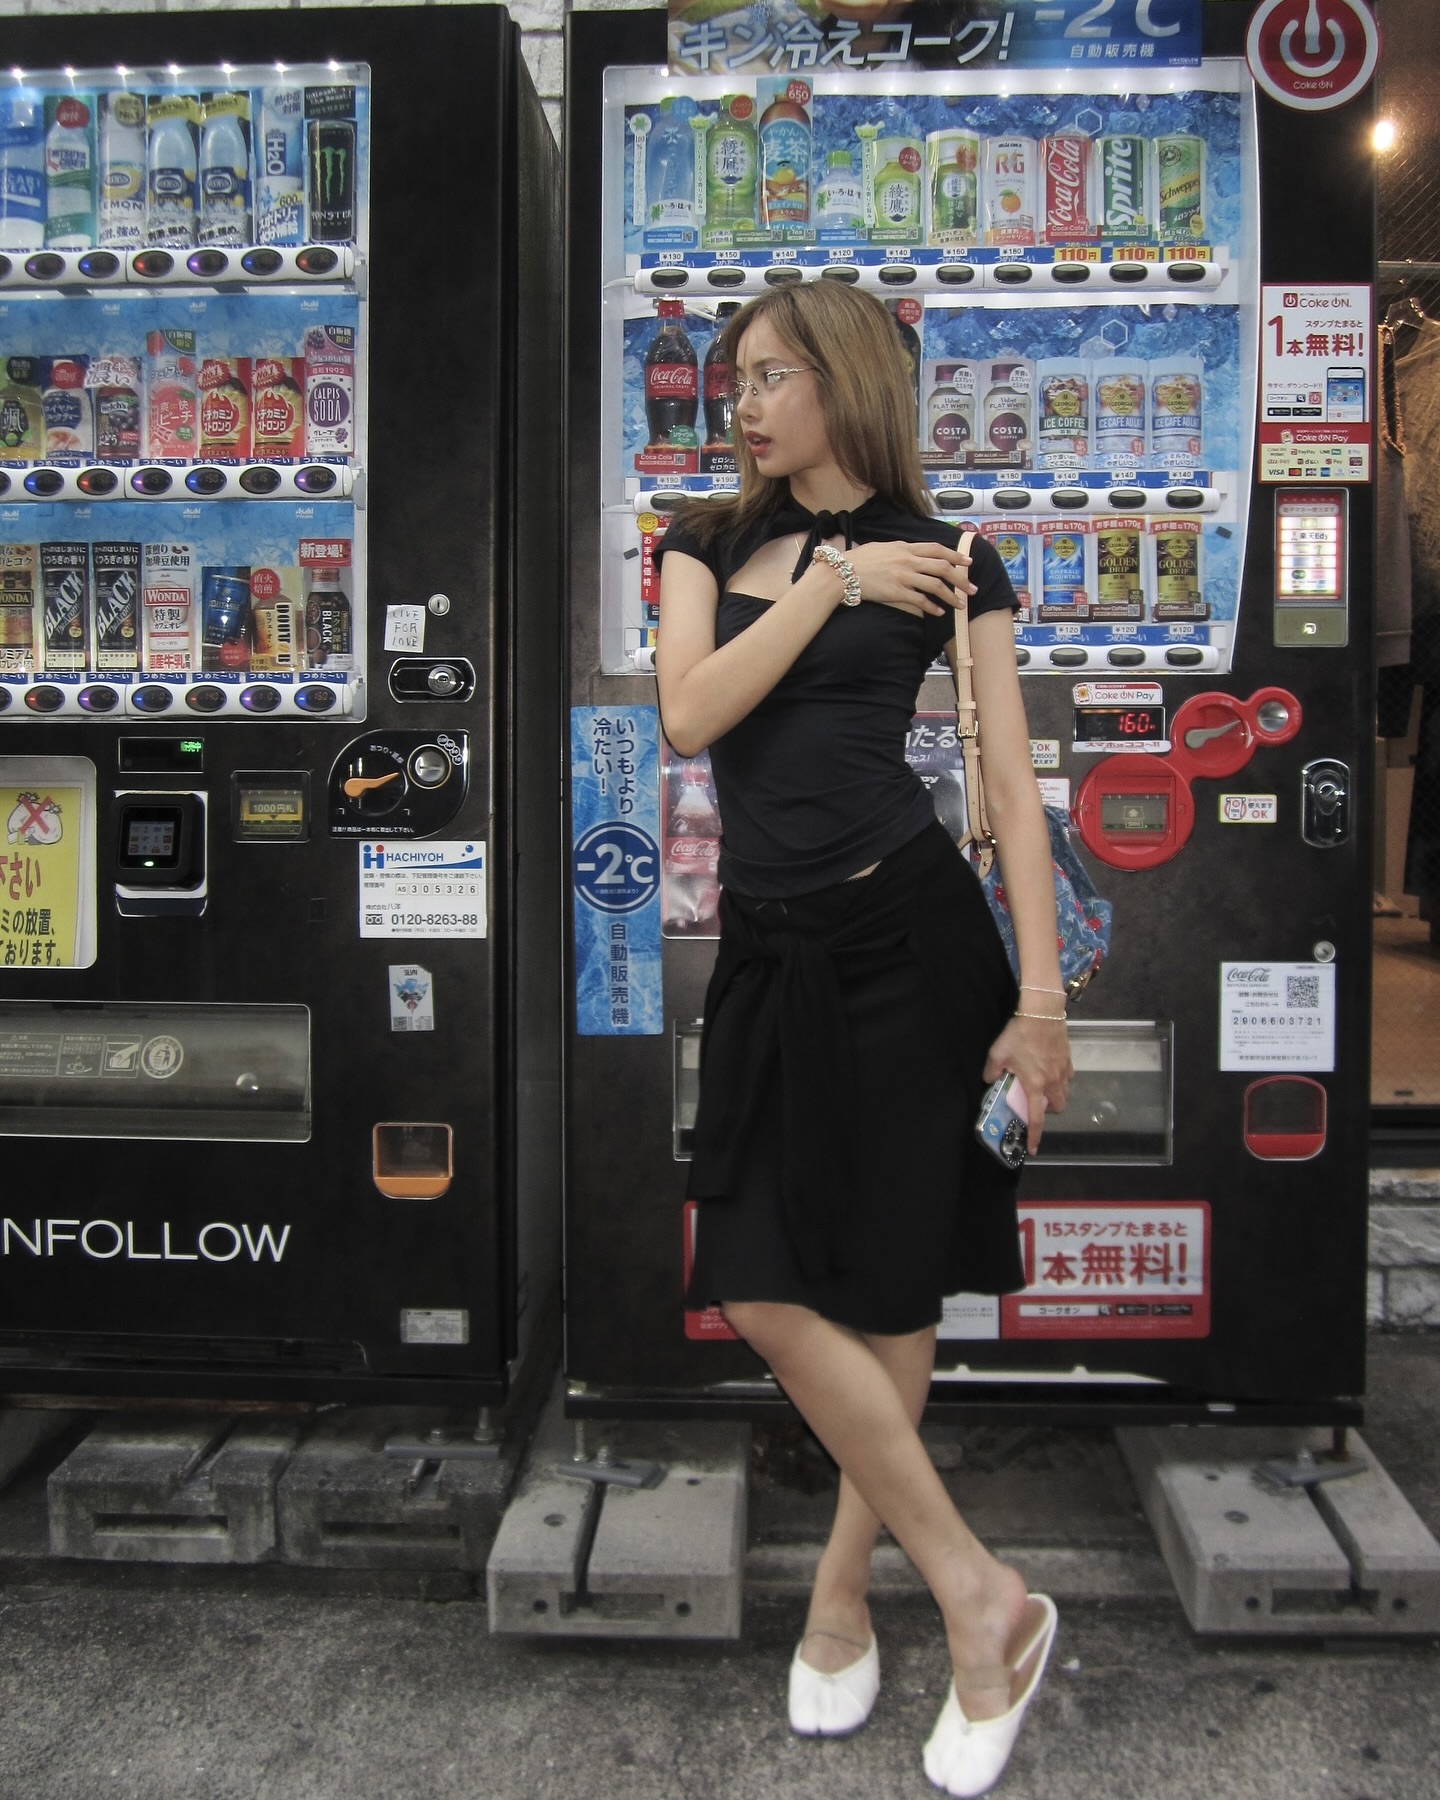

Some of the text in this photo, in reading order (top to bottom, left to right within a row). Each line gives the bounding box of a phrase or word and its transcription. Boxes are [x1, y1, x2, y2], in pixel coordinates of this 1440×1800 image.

[1070, 43, 1154, 59] 自動販売機
[1293, 81, 1318, 90] Coke
[787, 89, 809, 101] 650
[267, 137, 286, 176] H2O
[721, 137, 741, 175] 綾鷹
[765, 136, 809, 164] 麦茶
[995, 151, 1025, 175] RG
[1047, 138, 1081, 227] Coca-Cola
[1105, 138, 1133, 226] Sprite
[888, 183, 905, 214] 綾鷹
[775, 250, 795, 258] ¥140
[946, 248, 965, 256] ¥160
[1059, 247, 1097, 261] 110円
[1117, 247, 1155, 261] 110円
[1168, 247, 1206, 260] 110円
[1299, 298, 1329, 308] Coke
[1304, 319, 1364, 328] スタンプたまると
[650, 367, 693, 386] Coca-Cola
[313, 387, 341, 400] CALPIS
[313, 399, 342, 422] SODA
[160, 410, 194, 426] ピーチ
[1043, 417, 1086, 429] ICE COFFEE
[936, 426, 967, 436] COSTA
[992, 426, 1024, 435] COSTA
[1296, 434, 1318, 442] Coke
[1332, 434, 1349, 443] Pay
[145, 544, 169, 556] 深煎り
[300, 542, 344, 559] 新登場!
[145, 555, 190, 567] 珈琲豆使用
[1099, 557, 1138, 568] GOLDEN
[1158, 559, 1197, 569] GOLDEN
[147, 589, 186, 602] WONDA
[45, 571, 84, 641] BLACK
[97, 571, 136, 641] BLACK
[154, 608, 181, 622] 特製
[321, 609, 333, 644] BLACK
[394, 621, 418, 634] FOR
[391, 636, 419, 648] LOVE
[1094, 691, 1119, 700] Coke
[1136, 691, 1155, 702] Pay
[1119, 712, 1150, 733] 160
[1036, 743, 1051, 752] OK
[593, 717, 612, 794] 冷たい!
[616, 718, 635, 815] いつもより
[1252, 809, 1268, 819] OK
[386, 852, 444, 862] HACHIYOH
[391, 913, 478, 926] 0120-8263-88
[610, 923, 630, 1025] 自動販売機
[1227, 967, 1271, 982] Coca-Cola
[1043, 1221, 1189, 1238] 15スタンプたまると
[3, 1217, 291, 1263] NFOLLOW
[1039, 1306, 1081, 1316] コークオン
